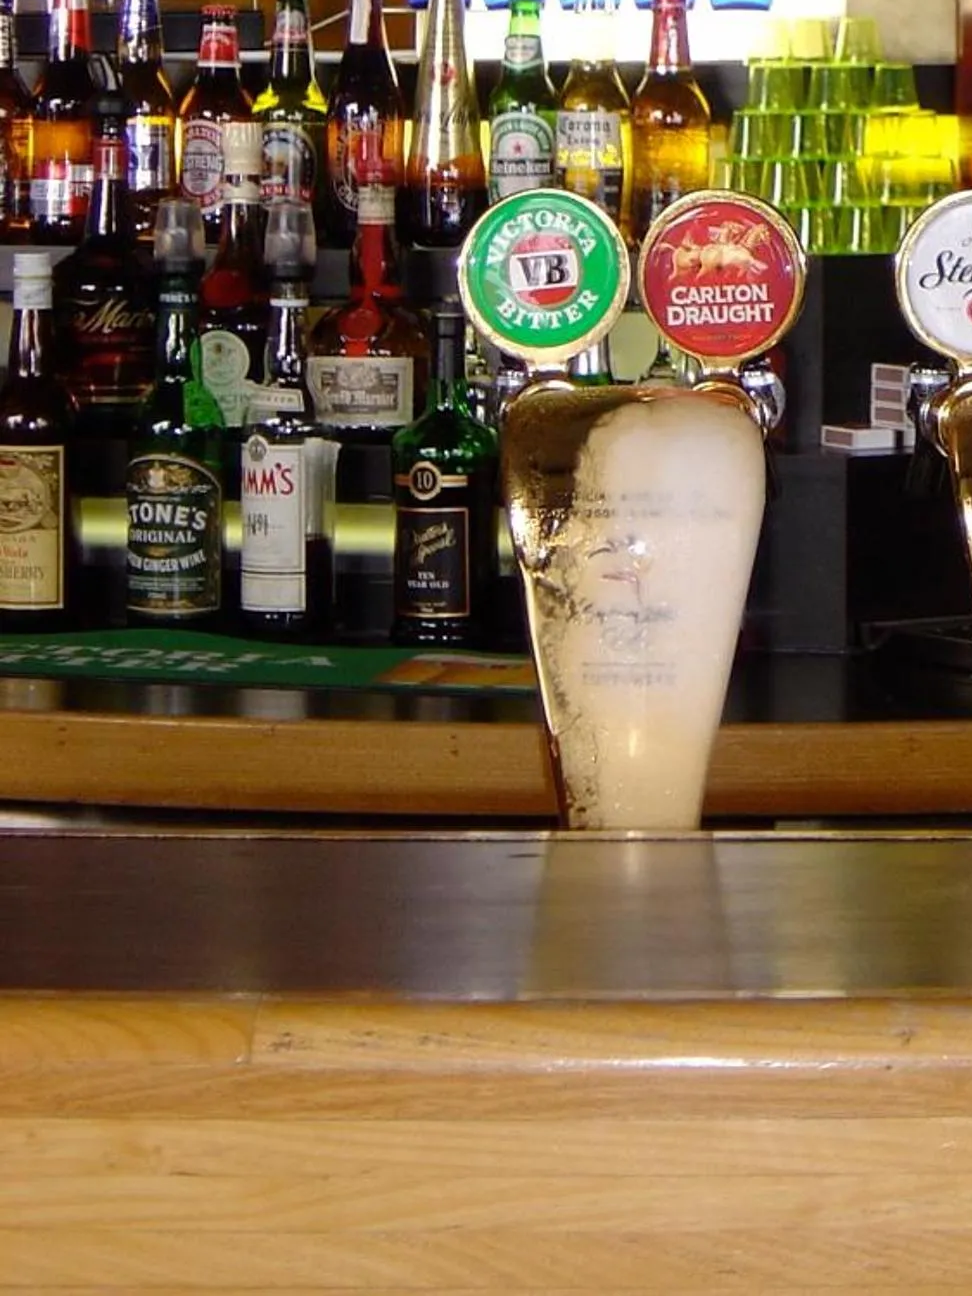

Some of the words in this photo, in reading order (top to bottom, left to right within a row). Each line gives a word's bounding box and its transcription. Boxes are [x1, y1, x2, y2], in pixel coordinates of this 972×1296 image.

[486, 210, 598, 267] VICTORIA
[516, 256, 571, 286] VB
[670, 283, 769, 305] CARLTON
[496, 288, 599, 331] BITTER
[666, 304, 775, 327] DRAUGHT
[127, 501, 208, 531] TONE'S
